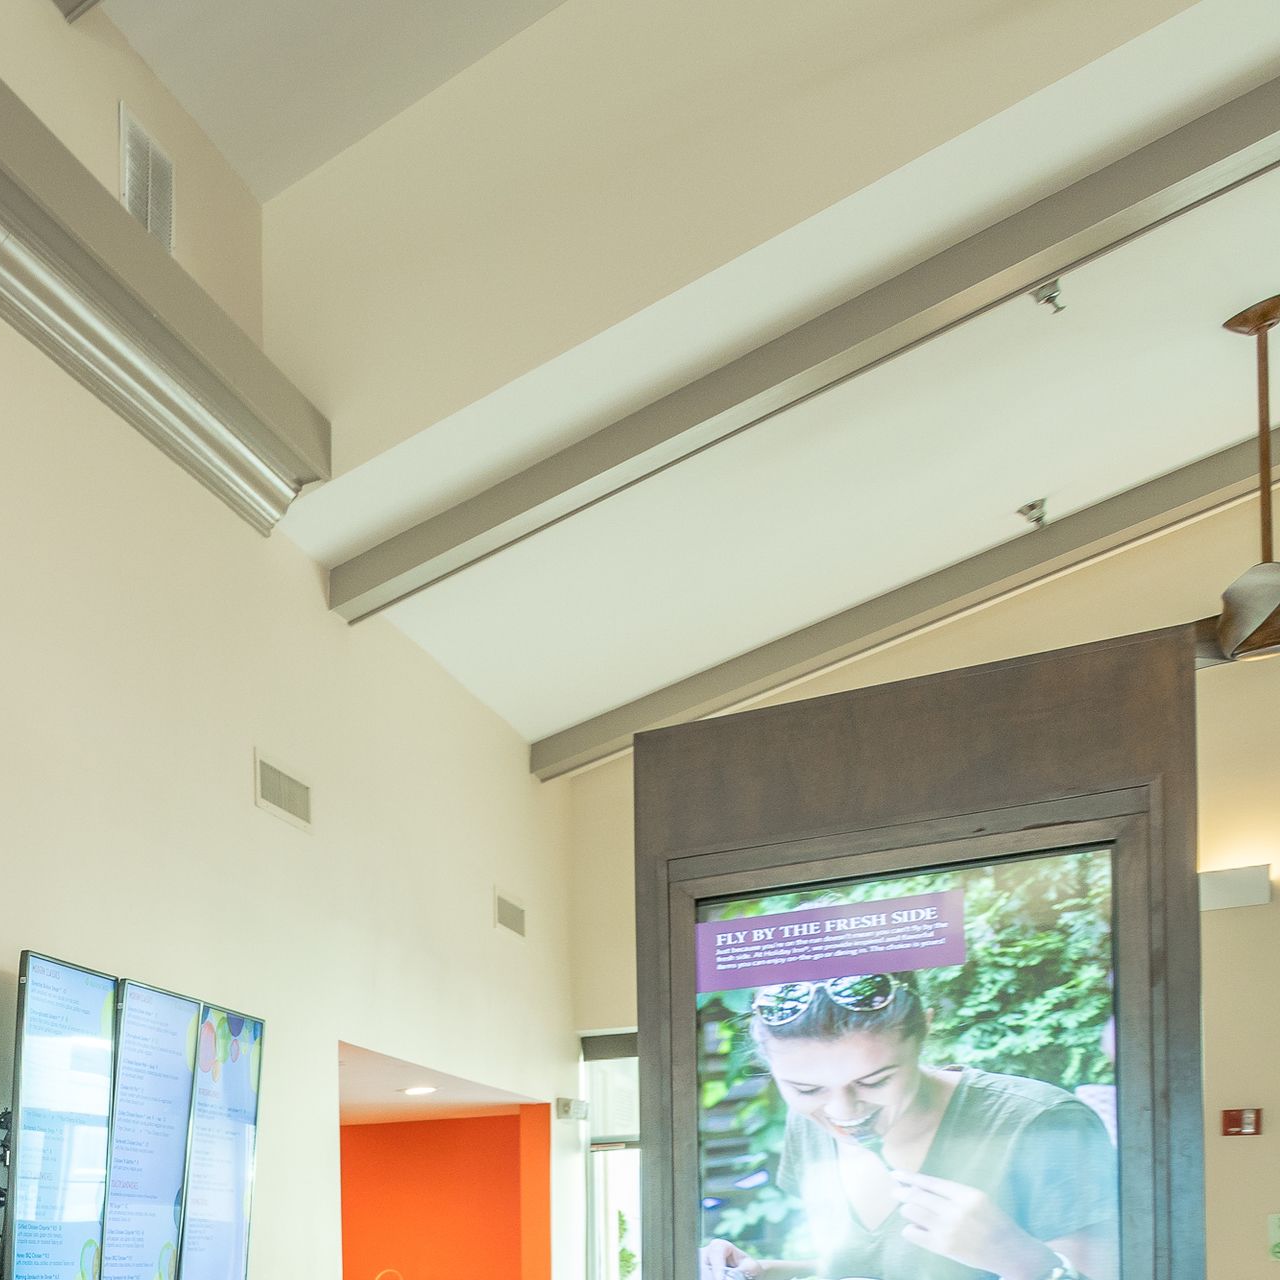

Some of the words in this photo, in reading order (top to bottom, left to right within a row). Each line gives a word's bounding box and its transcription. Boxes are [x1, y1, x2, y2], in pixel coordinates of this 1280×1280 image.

[716, 931, 749, 947] FLY
[752, 927, 777, 942] BY
[779, 922, 822, 938] THE
[824, 913, 887, 933] FRESH
[890, 907, 939, 925] SIDE
